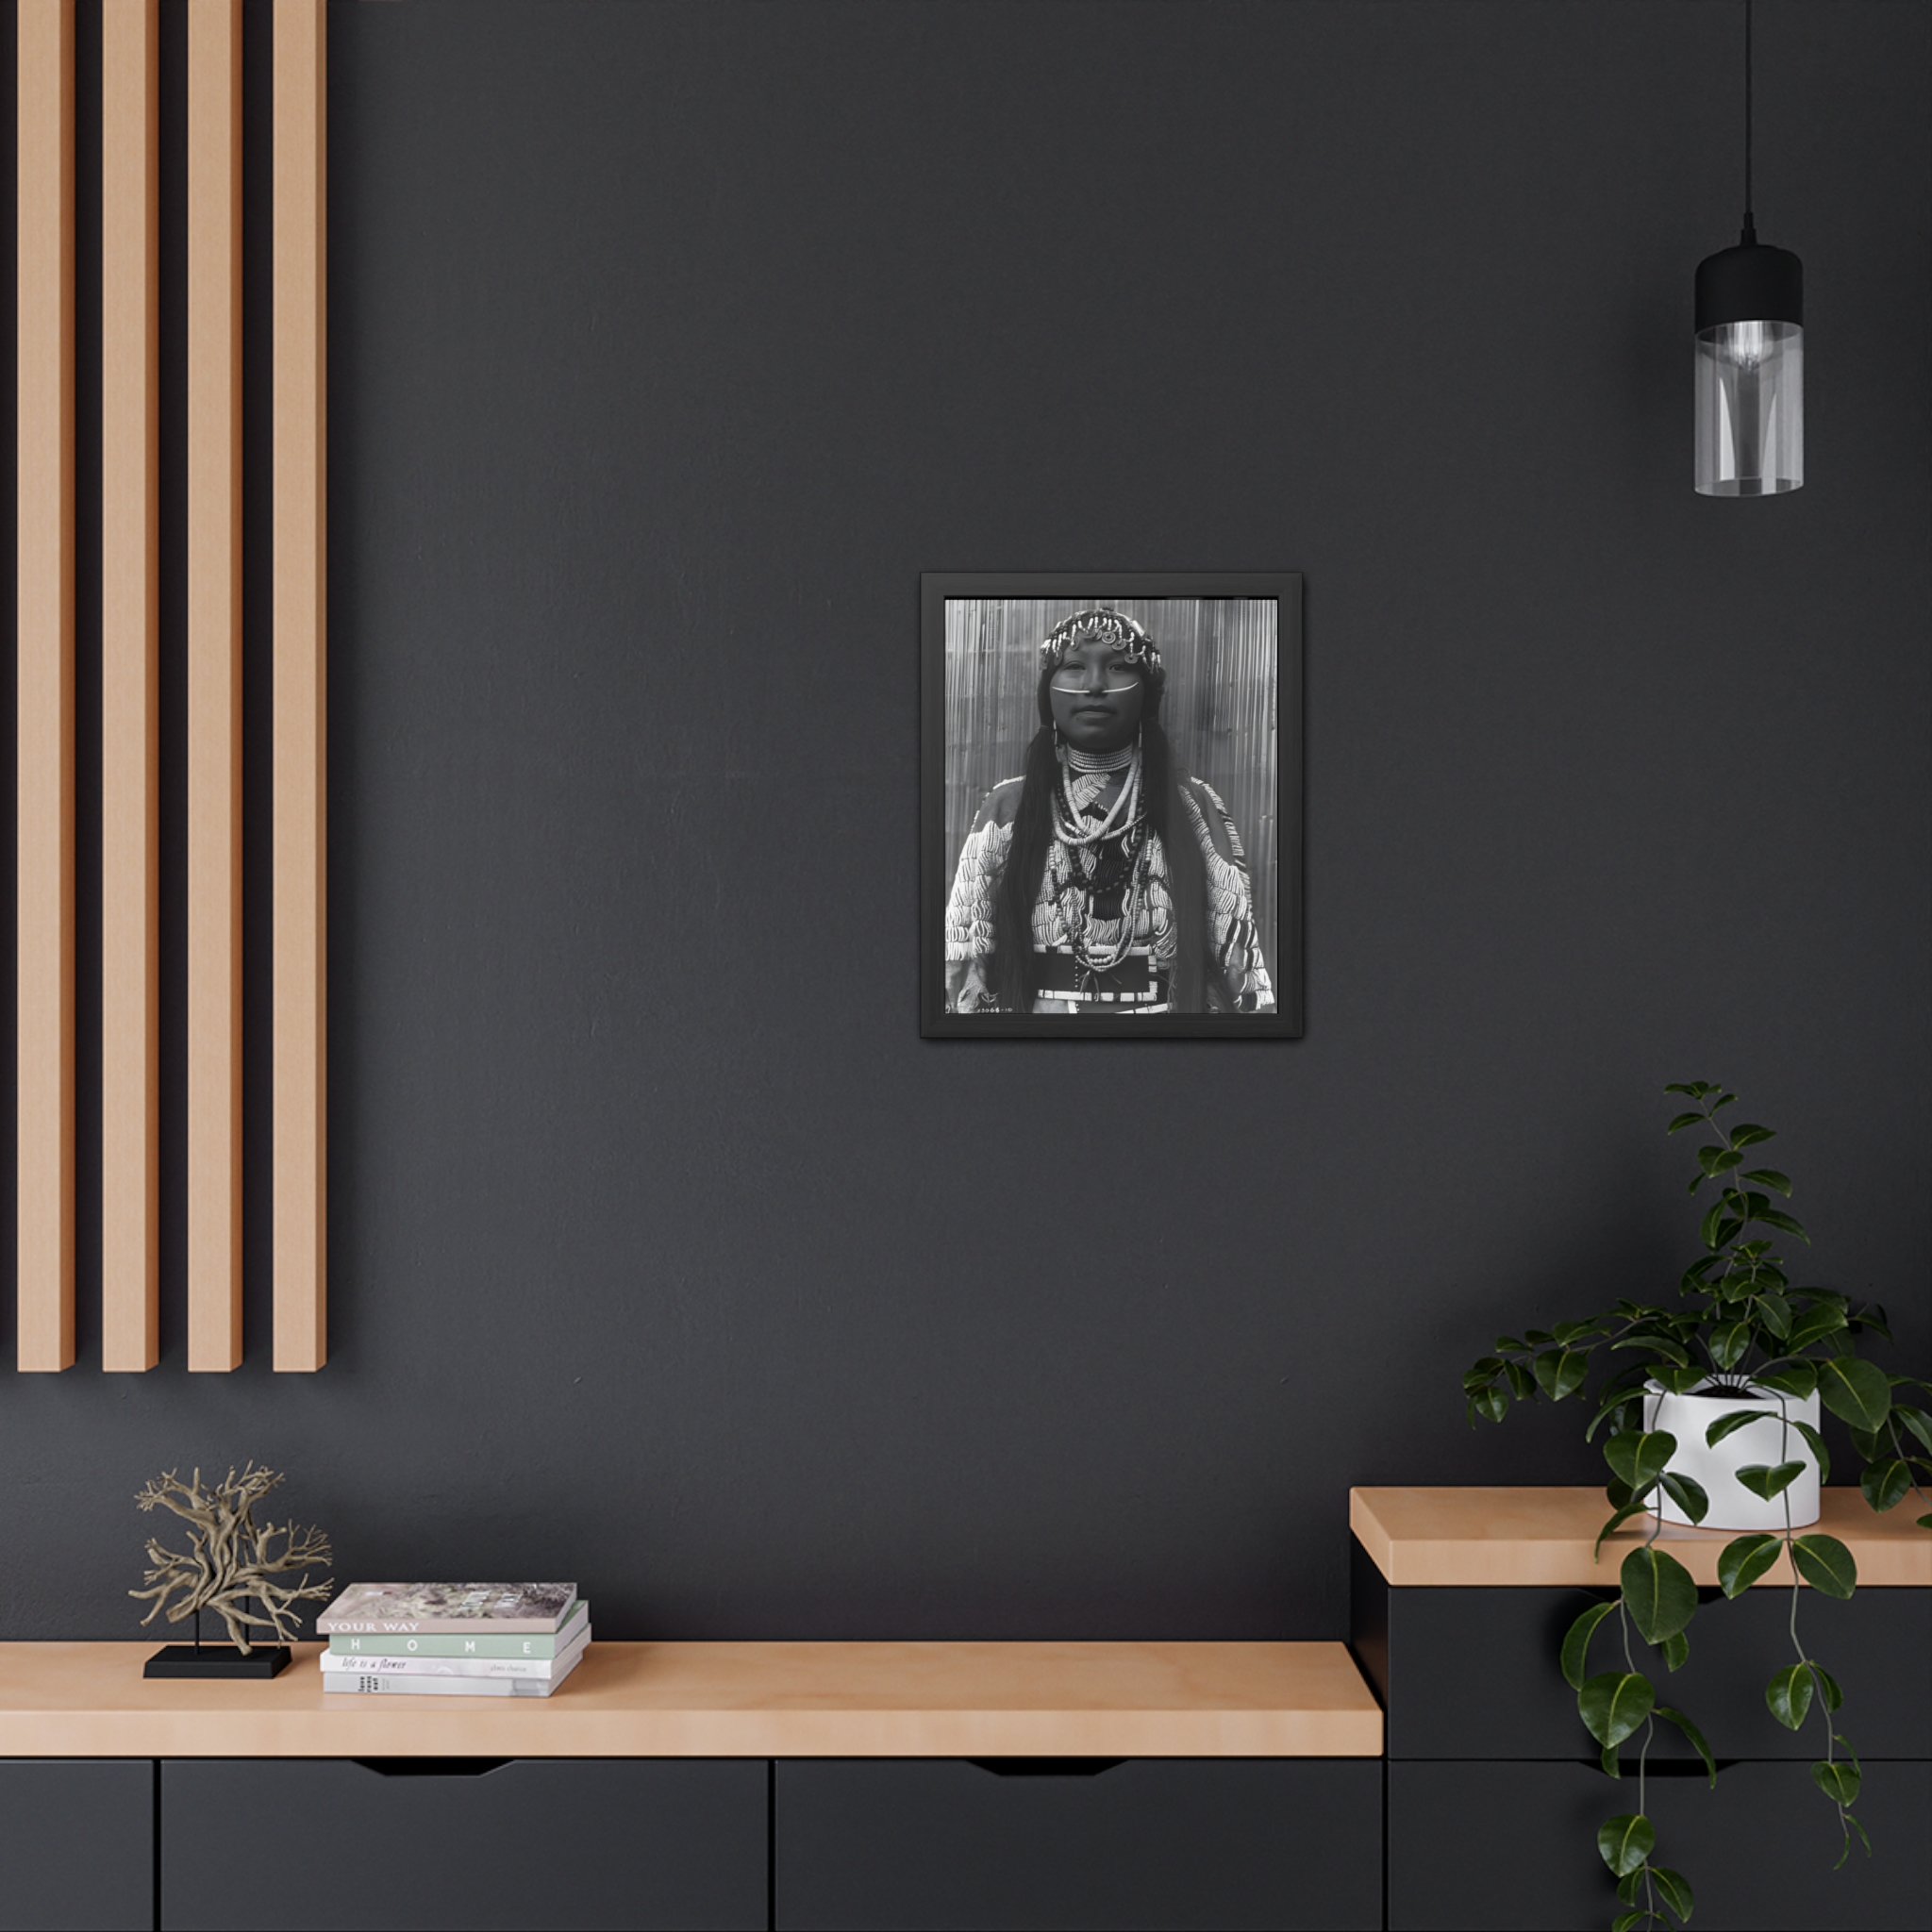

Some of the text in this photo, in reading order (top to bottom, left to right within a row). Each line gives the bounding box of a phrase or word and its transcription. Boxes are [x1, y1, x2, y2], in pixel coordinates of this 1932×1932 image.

[327, 1623, 420, 1632] YOUR WAY
[351, 1639, 531, 1654] HOME
